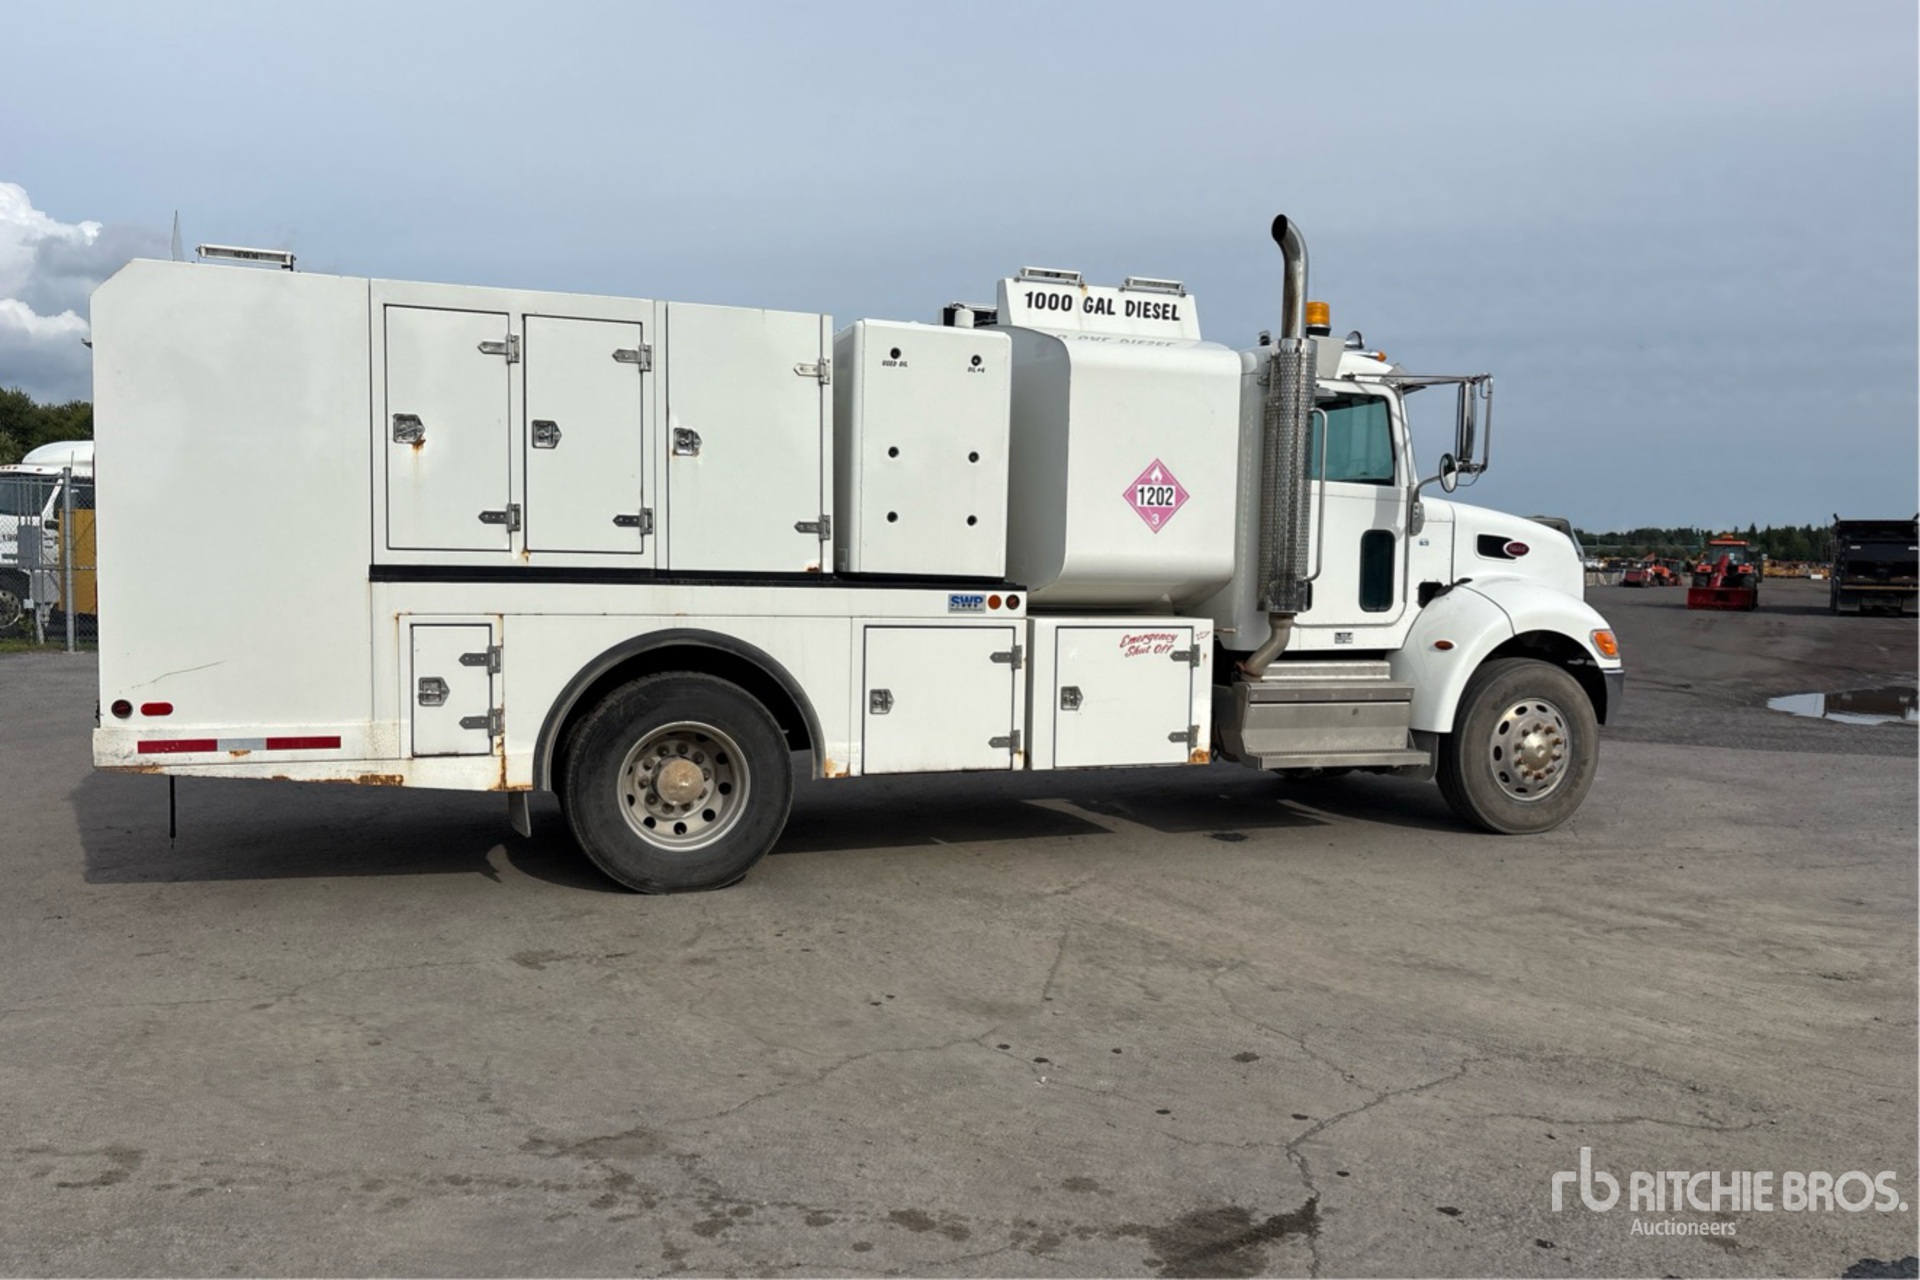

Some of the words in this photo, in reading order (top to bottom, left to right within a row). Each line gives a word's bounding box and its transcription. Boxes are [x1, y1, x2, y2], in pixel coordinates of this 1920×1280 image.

[1025, 291, 1073, 312] 1000
[1083, 296, 1116, 316] GAL
[1125, 300, 1181, 321] DIESEL
[1138, 486, 1174, 506] 1202
[1151, 513, 1159, 525] 3
[951, 595, 983, 605] SWP
[1119, 633, 1178, 648] Emergency
[1124, 645, 1151, 658] Shut
[1153, 644, 1174, 654] Off
